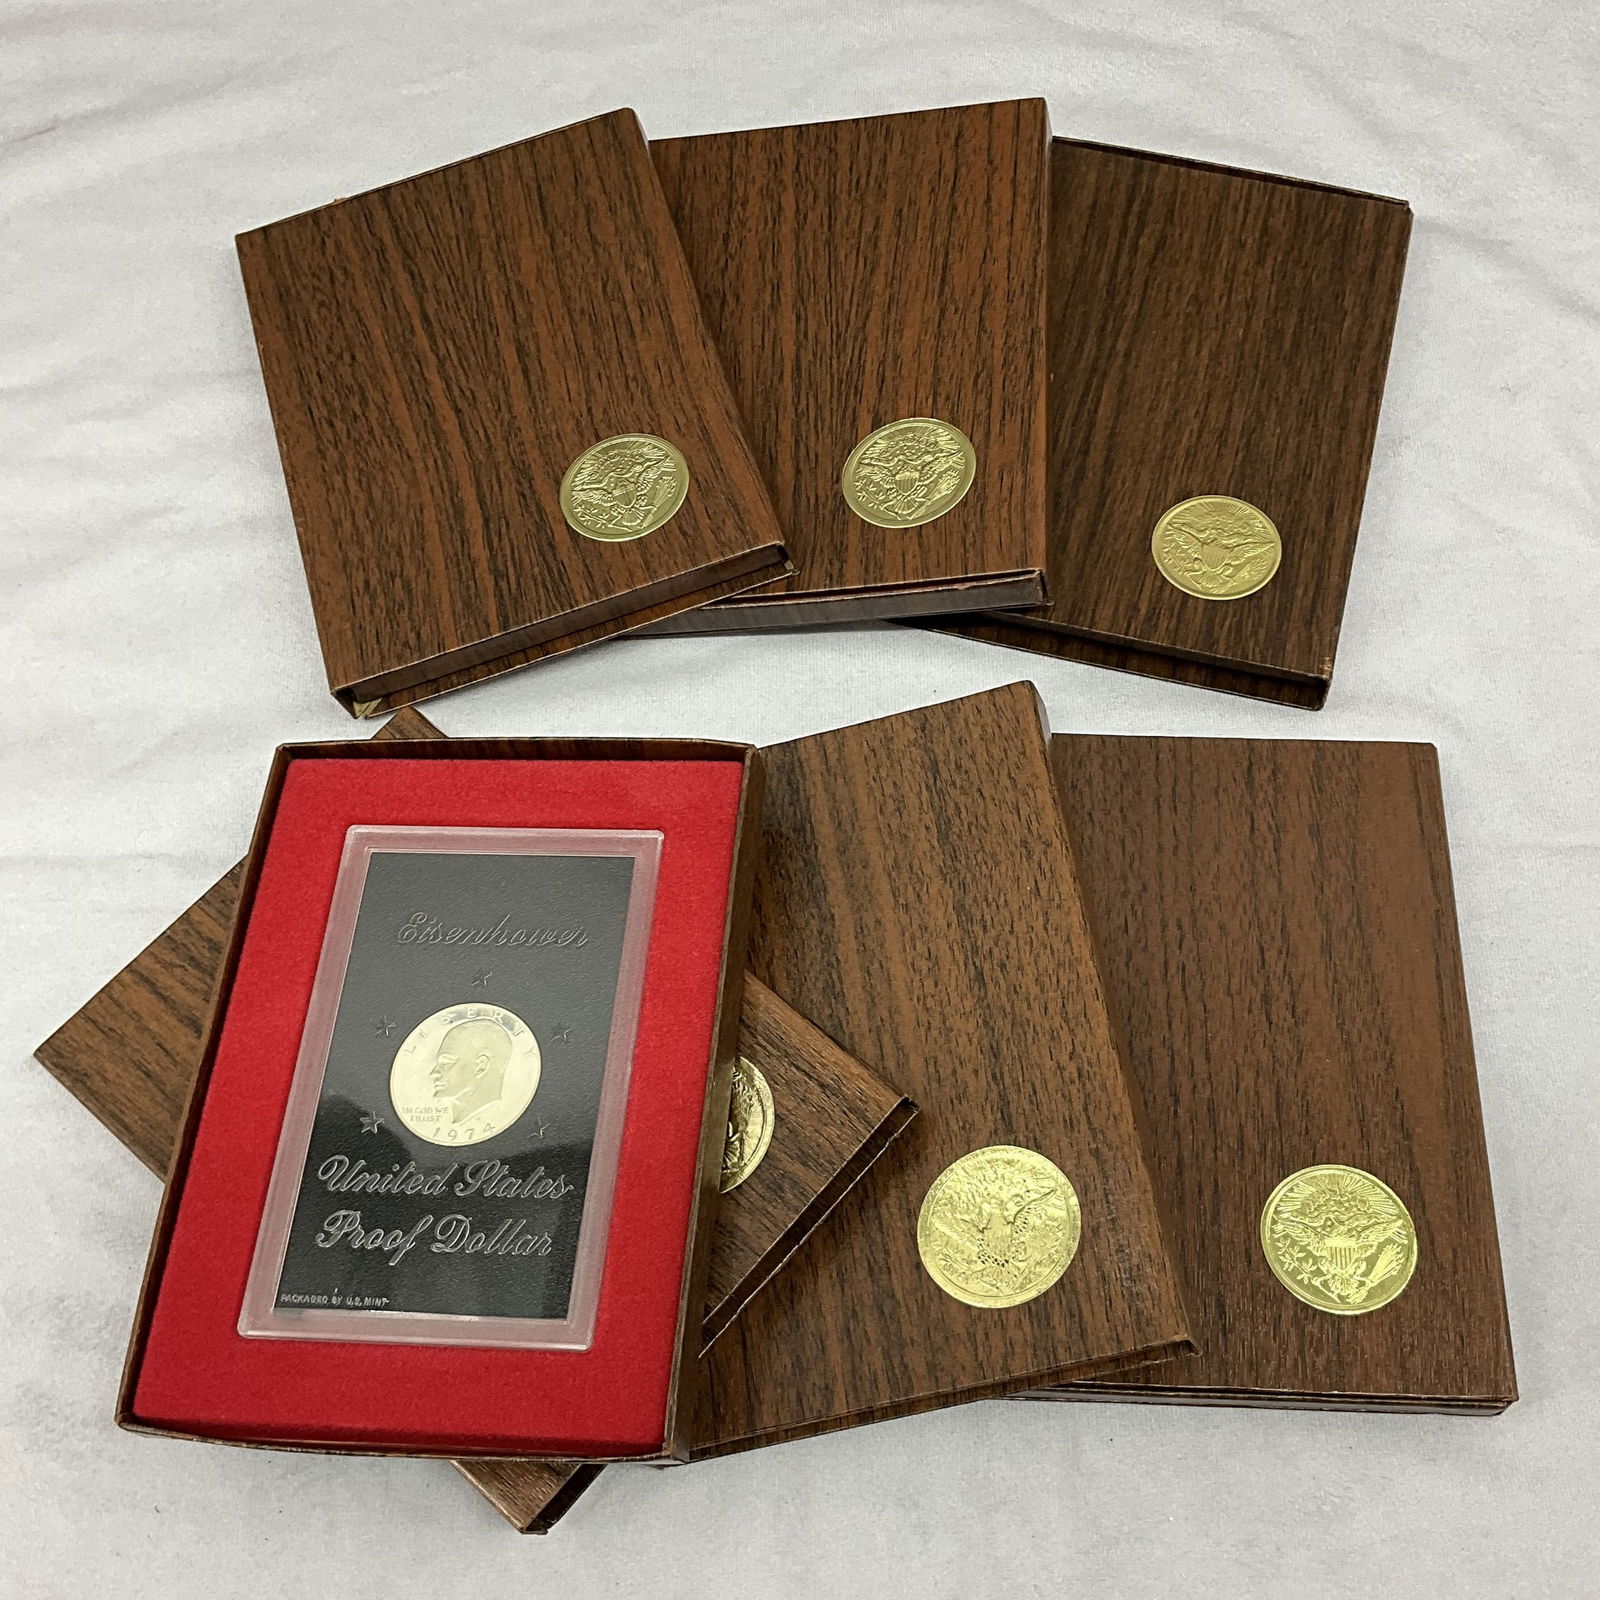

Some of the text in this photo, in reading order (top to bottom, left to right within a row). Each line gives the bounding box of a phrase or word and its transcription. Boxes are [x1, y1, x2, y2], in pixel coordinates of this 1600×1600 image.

[397, 911, 588, 947] Eisenhower
[433, 1122, 496, 1141] 1974
[317, 1154, 574, 1199] United States
[315, 1209, 552, 1266] Proof Dollar
[281, 1294, 329, 1304] PACKAGED
[331, 1295, 343, 1305] BY
[363, 1296, 389, 1307] MINT
